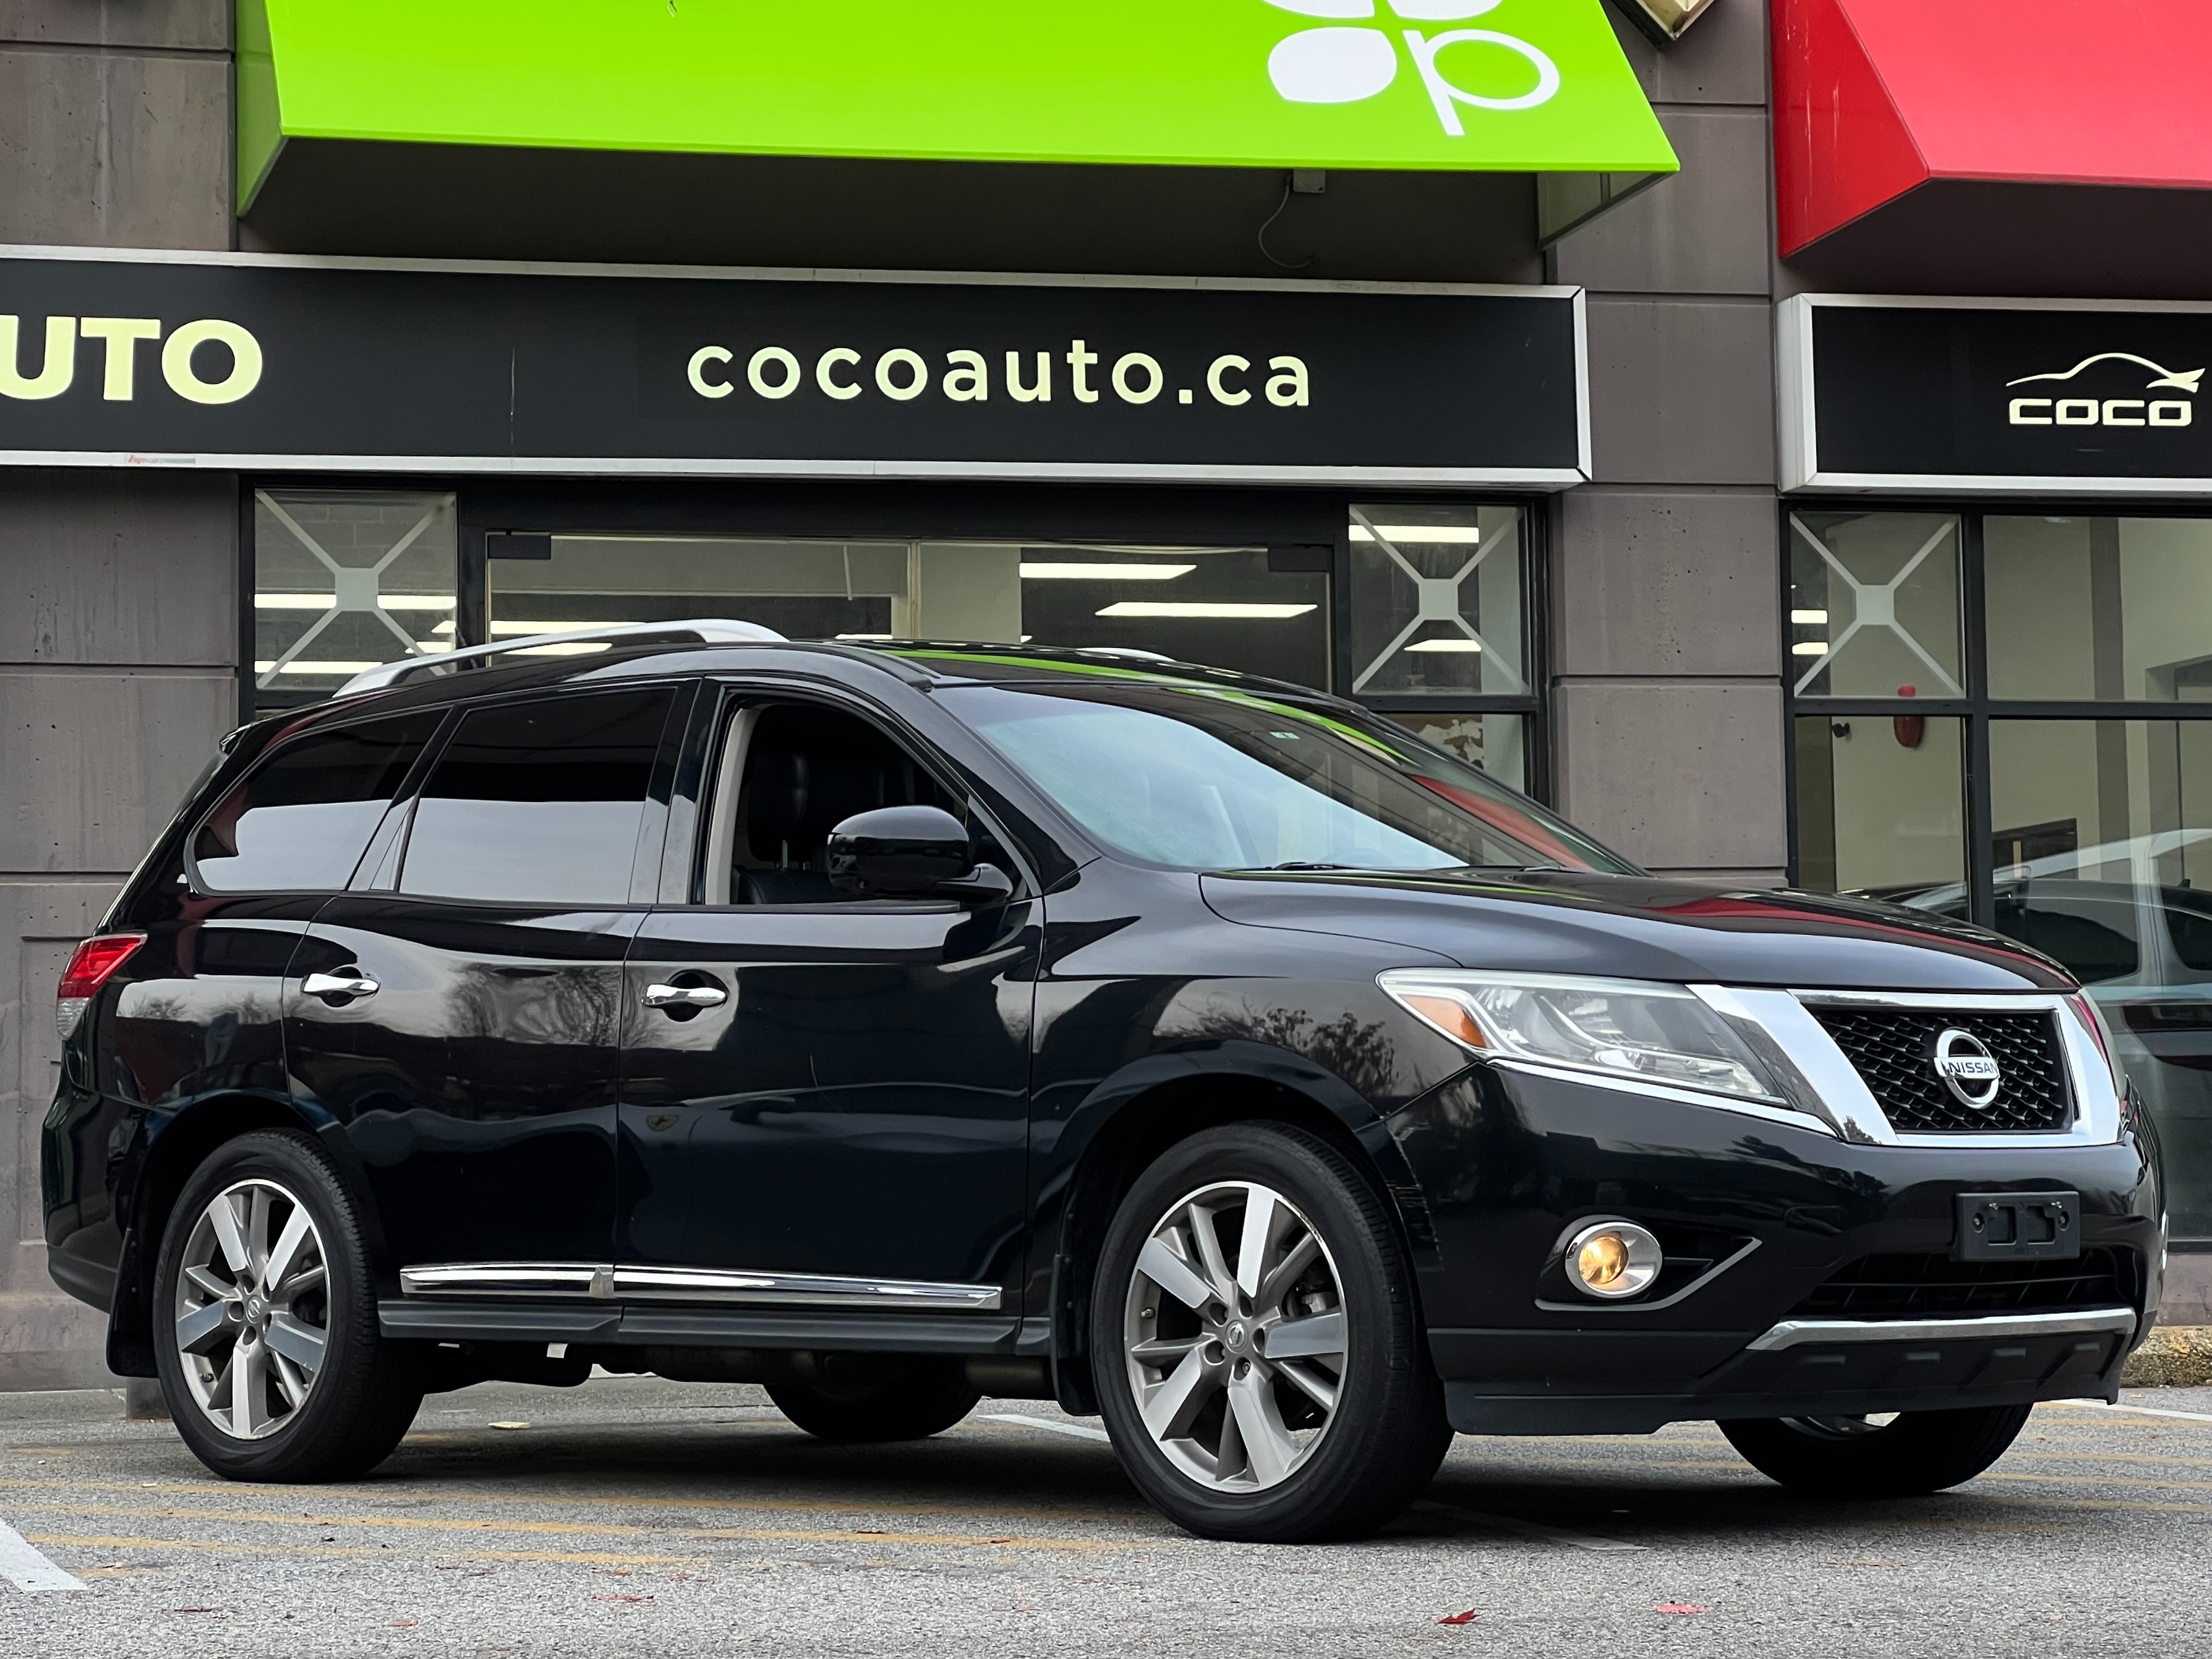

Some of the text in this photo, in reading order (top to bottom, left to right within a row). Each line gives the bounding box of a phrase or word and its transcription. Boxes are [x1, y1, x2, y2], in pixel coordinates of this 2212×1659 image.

[687, 339, 1310, 407] cocoauto.ca
[2009, 398, 2192, 427] COCO
[1948, 1061, 1999, 1073] NISSAN
